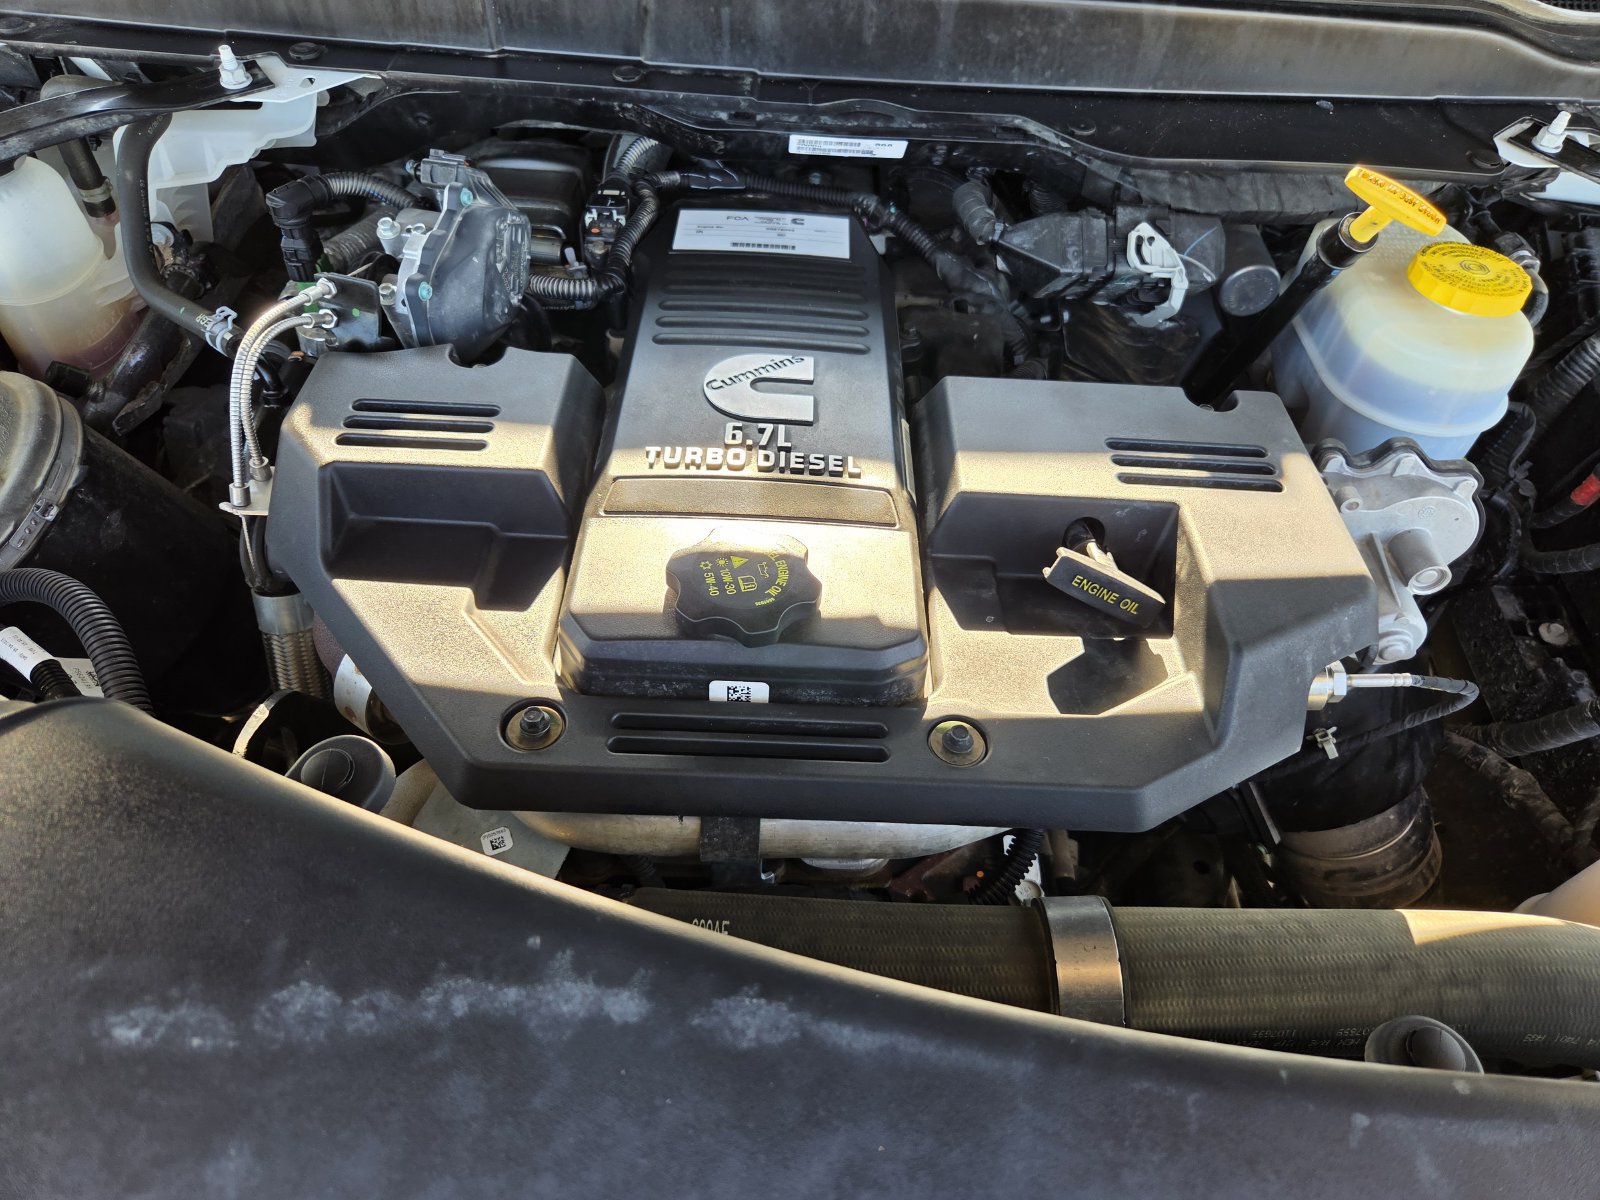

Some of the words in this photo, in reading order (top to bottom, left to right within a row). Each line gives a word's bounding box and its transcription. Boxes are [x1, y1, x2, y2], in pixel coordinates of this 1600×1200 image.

[706, 355, 805, 390] Cummins
[724, 422, 792, 452] 6.7L
[644, 445, 746, 471] TURBO
[757, 449, 862, 478] DIESEL
[703, 572, 720, 597] 5W-40
[719, 568, 737, 595] 10W-30
[775, 560, 789, 587] ENGINE
[764, 585, 782, 597] OIL
[1071, 575, 1120, 604] ENGINE
[1119, 598, 1140, 615] OIL
